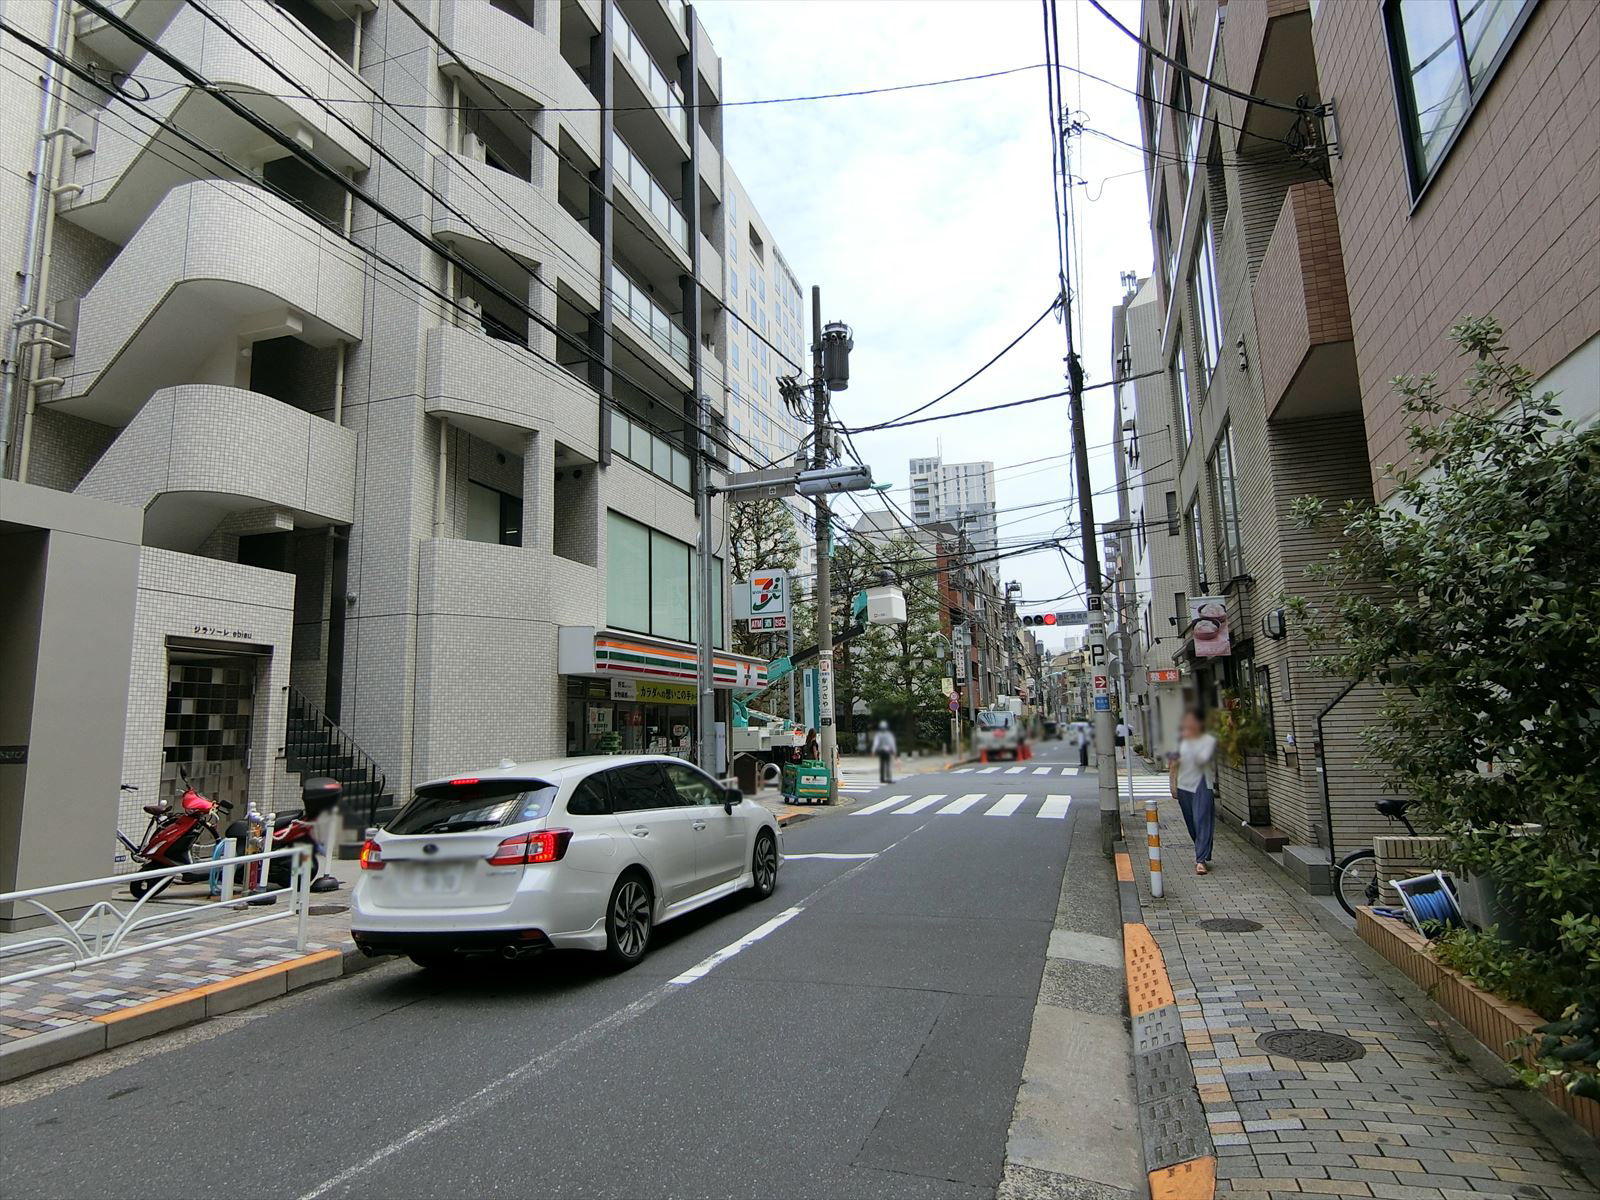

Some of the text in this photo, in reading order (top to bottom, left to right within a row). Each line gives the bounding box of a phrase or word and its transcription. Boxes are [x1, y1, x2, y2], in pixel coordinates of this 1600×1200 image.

[1089, 598, 1099, 610] P
[194, 625, 252, 639] ジラソーレ ebisu
[1091, 644, 1105, 666] P
